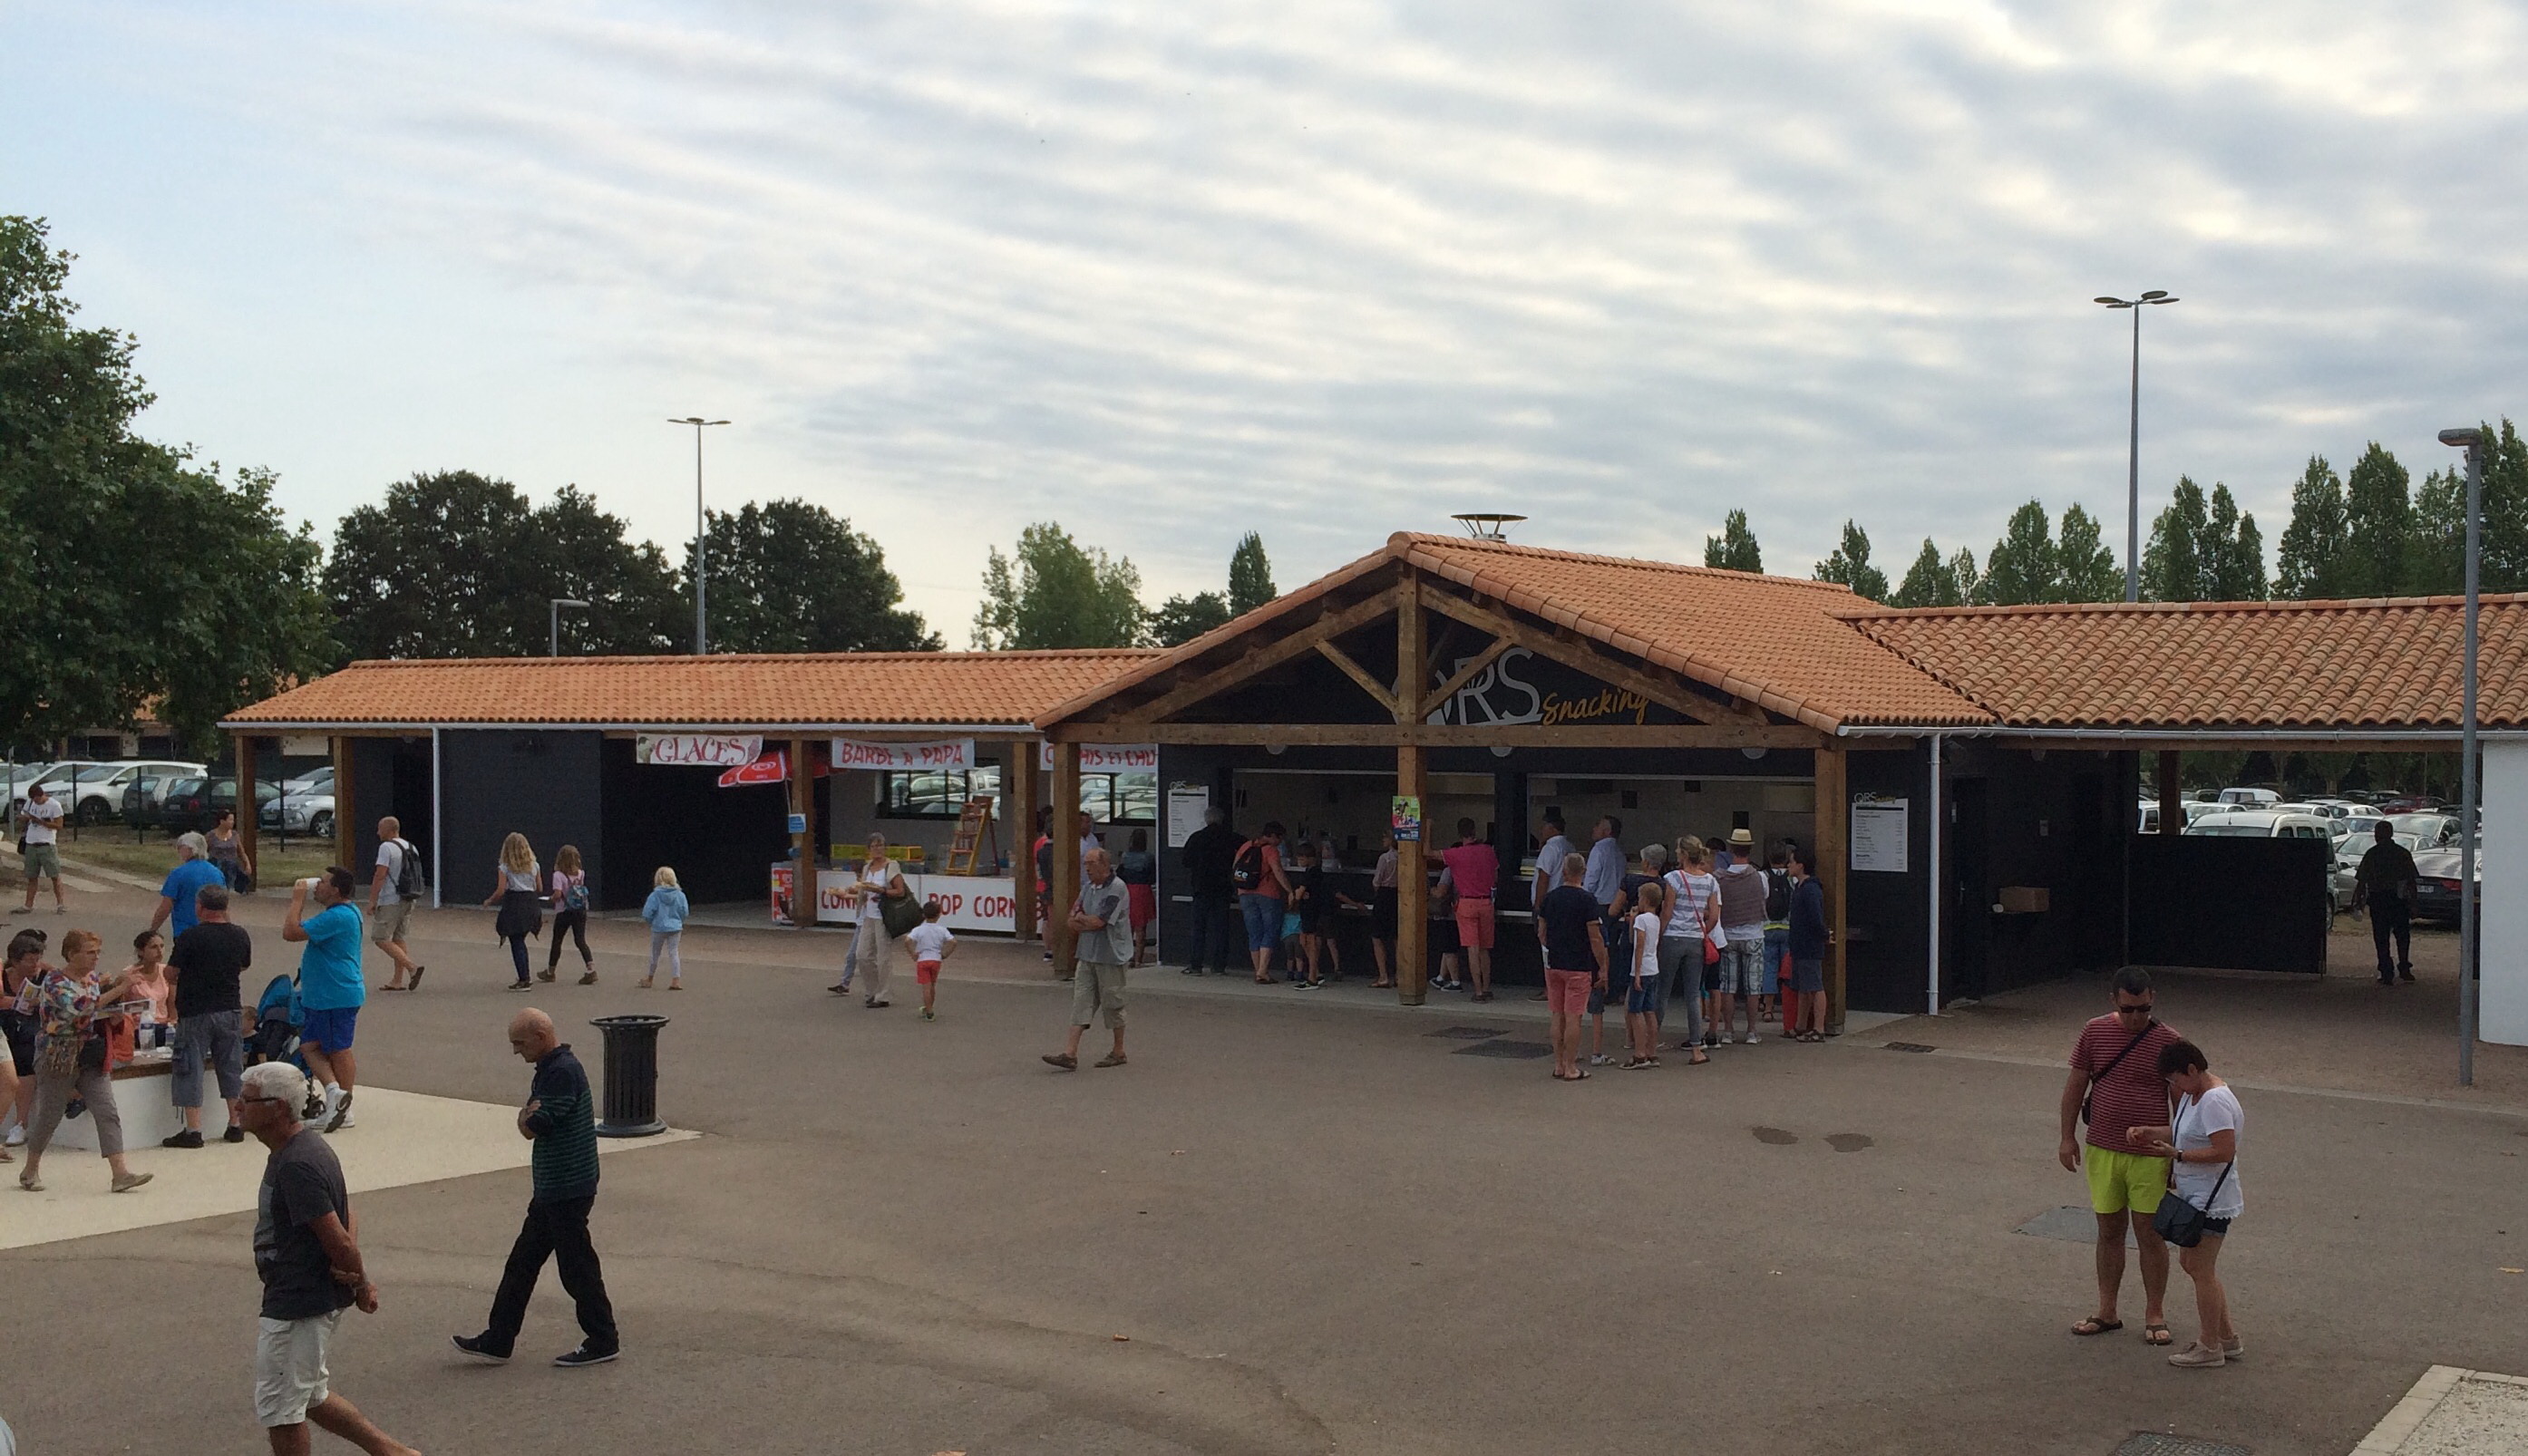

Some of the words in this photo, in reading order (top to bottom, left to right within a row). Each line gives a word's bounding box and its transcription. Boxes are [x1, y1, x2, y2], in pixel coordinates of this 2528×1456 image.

[1542, 688, 1648, 725] Snacking
[655, 737, 746, 764] GLACES
[841, 742, 894, 765] BARBE
[919, 743, 964, 765] PAPA
[1106, 751, 1123, 765] ET
[1125, 750, 1158, 766] CHU
[928, 893, 964, 916] POP
[974, 896, 1016, 918] CORN
